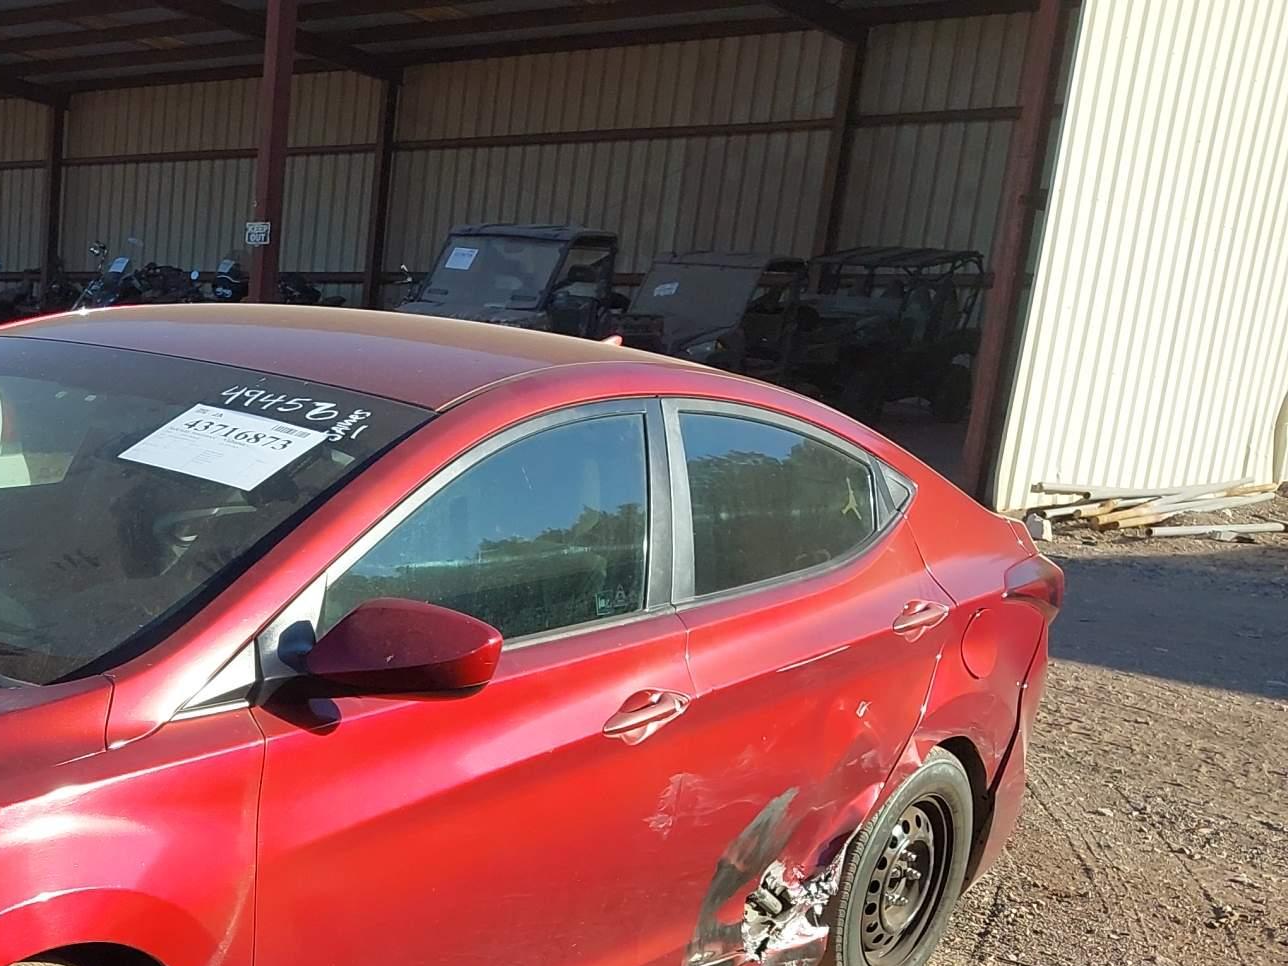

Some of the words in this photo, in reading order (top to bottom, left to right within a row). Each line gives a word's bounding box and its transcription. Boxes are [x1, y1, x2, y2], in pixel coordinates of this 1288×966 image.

[248, 224, 268, 233] KEEP
[249, 233, 266, 242] OUT
[184, 419, 293, 451] 43716873
